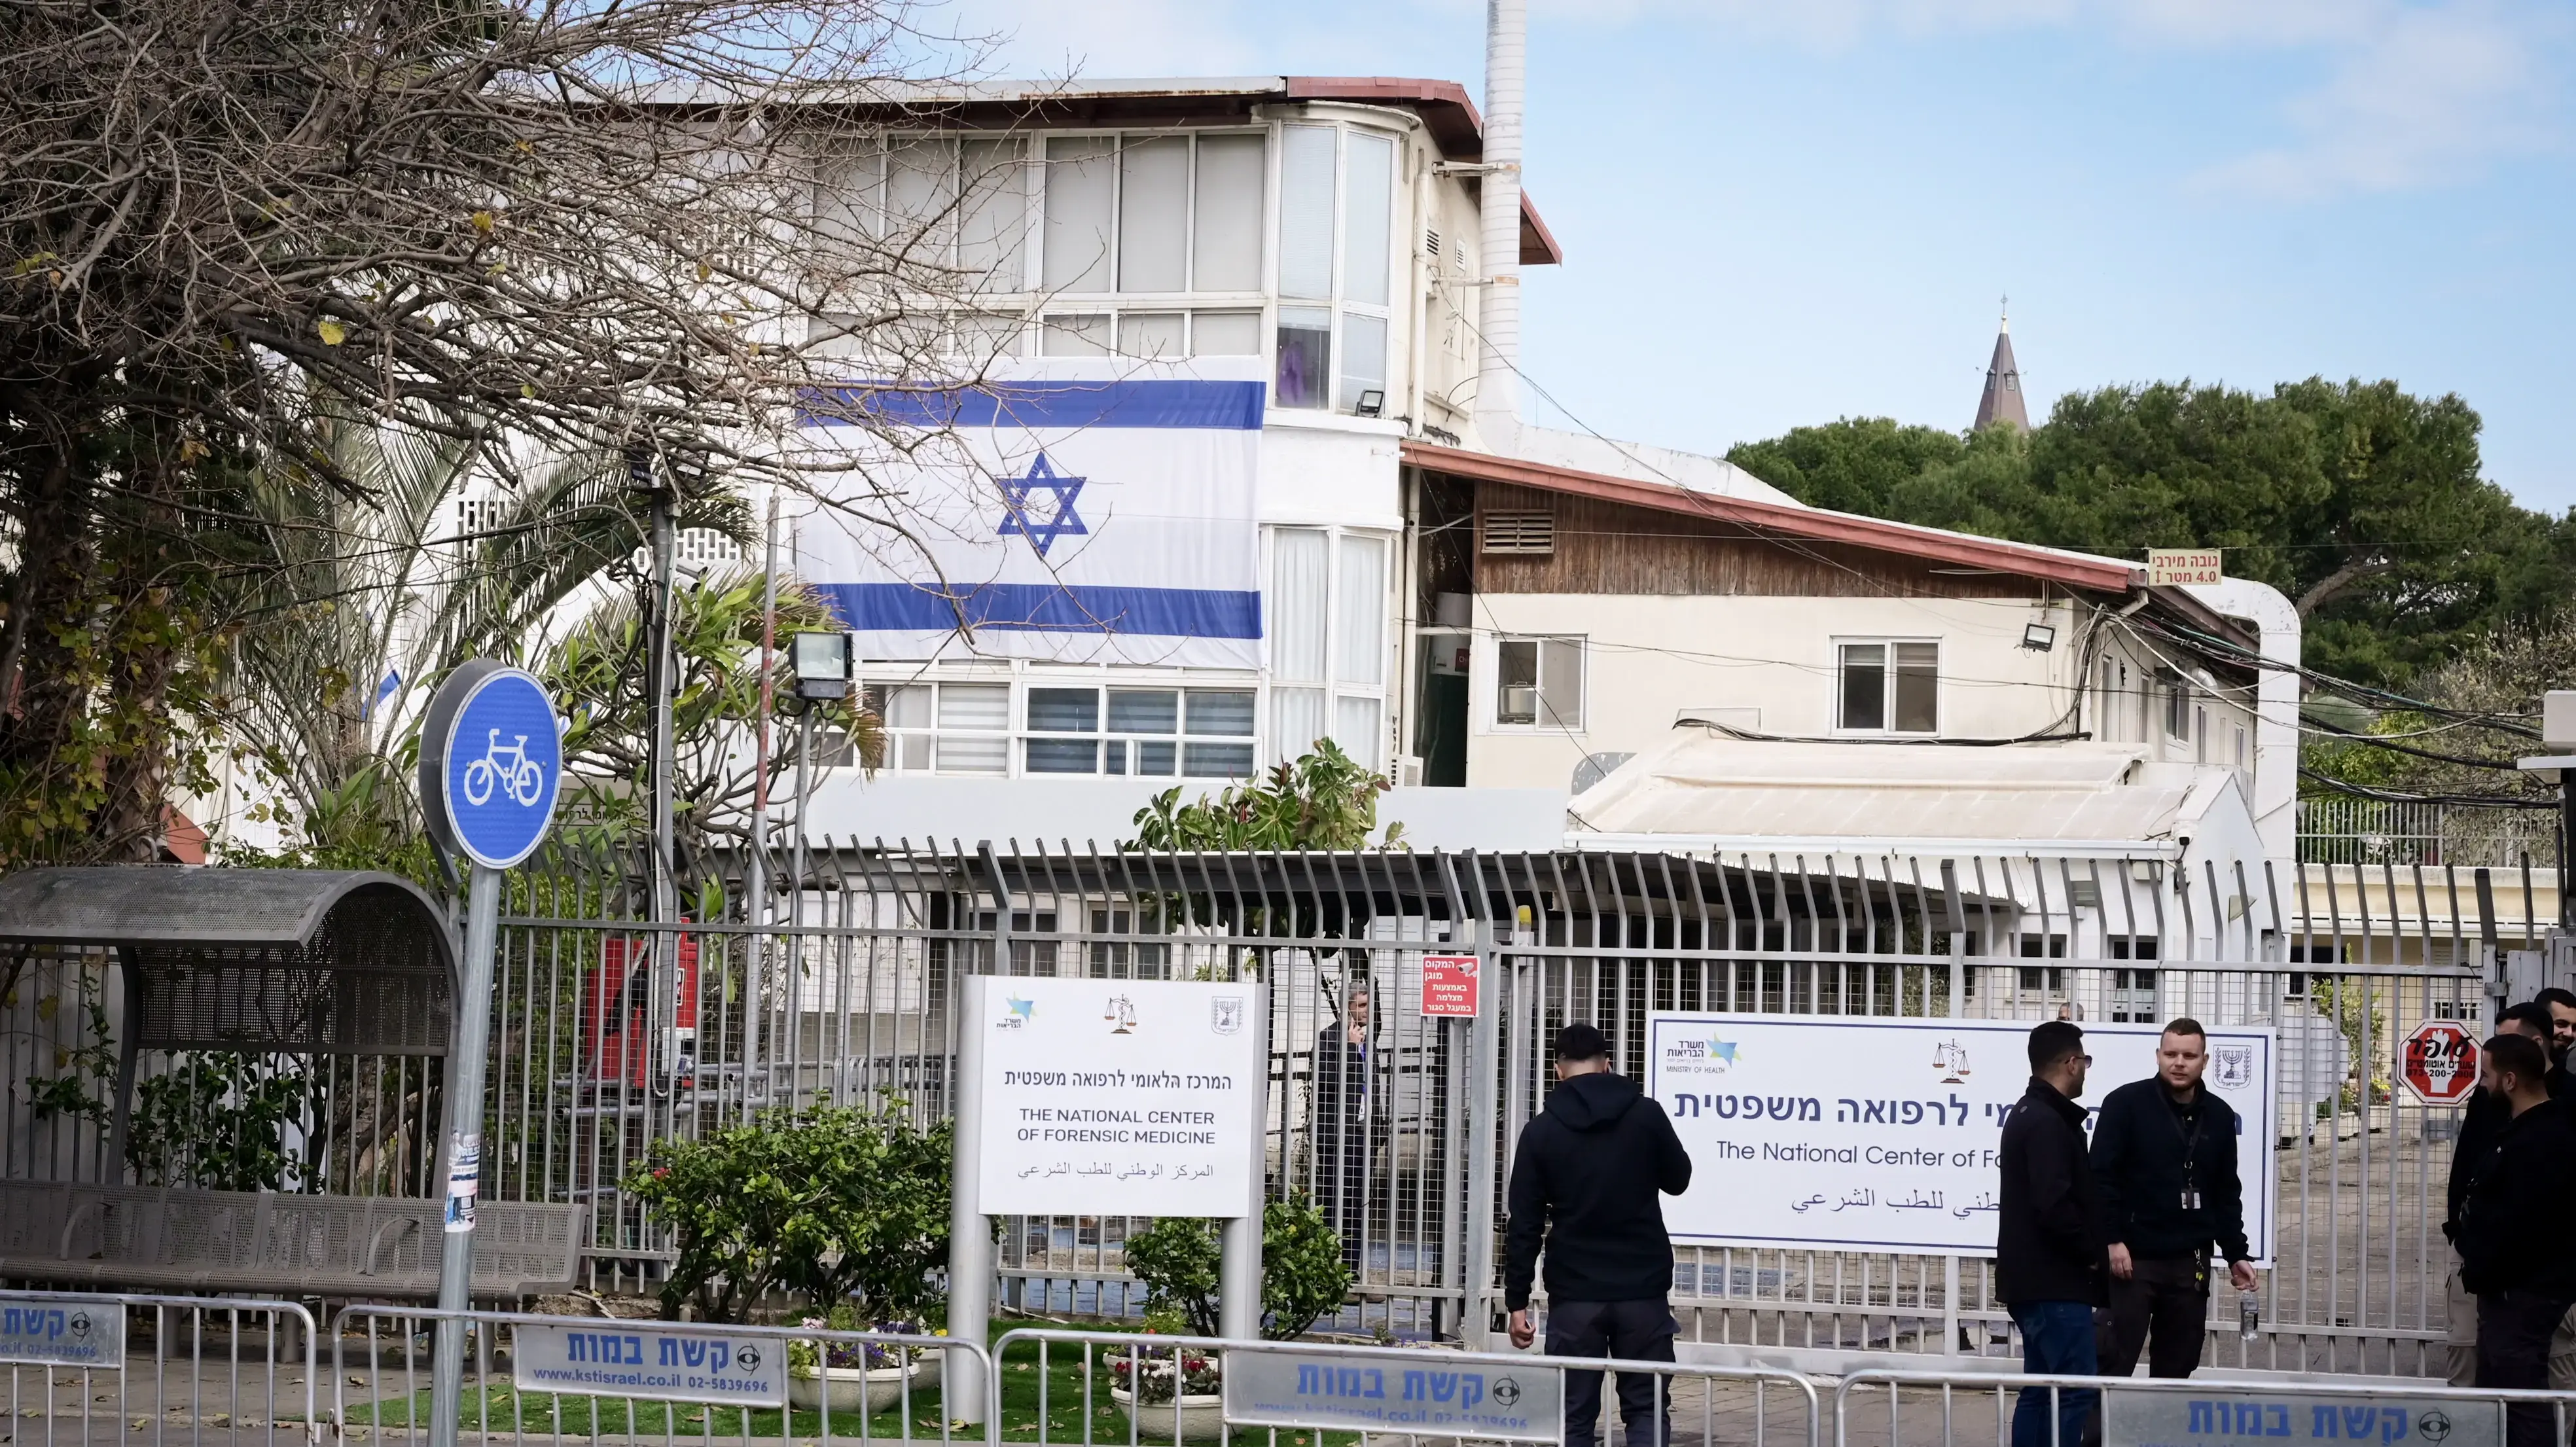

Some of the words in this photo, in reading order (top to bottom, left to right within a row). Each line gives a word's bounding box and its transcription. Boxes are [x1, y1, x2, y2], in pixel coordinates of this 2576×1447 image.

[2153, 556, 2186, 567] מירבי
[2191, 556, 2218, 567] גובה
[2166, 572, 2192, 582] מטר
[2196, 571, 2217, 582] 4.0
[1425, 960, 1455, 970] המקום
[1425, 972, 1443, 981] מוגן
[1437, 993, 1463, 1001] מצלמה
[1446, 1003, 1472, 1012] במעגל
[1667, 1049, 1704, 1058] הבריאות
[2408, 1035, 2473, 1058] סופר
[2448, 1060, 2475, 1069] שערים
[1005, 1070, 1066, 1086] משפטית
[1072, 1069, 1126, 1088] לרפואה
[1131, 1070, 1181, 1089] הלאומי
[1187, 1075, 1232, 1090] המרכז
[1019, 1108, 1052, 1122] THE
[1057, 1109, 1143, 1123] NATIONAL
[1148, 1111, 1215, 1124] CENTER
[1674, 1094, 1821, 1121] משפטית
[1838, 1094, 1968, 1126] לרפואה
[1017, 1128, 1039, 1141] OF
[1045, 1129, 1129, 1143] FORENSIC
[1134, 1131, 1216, 1145] MEDICINE
[1717, 1141, 1755, 1159] The
[1764, 1143, 1857, 1163] National
[1865, 1146, 1945, 1166] Center
[1952, 1150, 1976, 1167] of
[1018, 1162, 1070, 1179] الشرعي
[1077, 1162, 1112, 1179] للطب
[1116, 1164, 1163, 1181] الوطني
[1172, 1165, 1214, 1179] المركز
[1792, 1187, 1875, 1214] الشرعي
[1886, 1188, 1943, 1213] للطب
[4, 1308, 64, 1341] קשת
[567, 1332, 643, 1365] במות
[658, 1337, 729, 1374] קשת
[533, 1368, 681, 1388] www.kstisrael.co.il
[688, 1376, 768, 1393] 02-5839696
[1297, 1363, 1385, 1399] במות
[1403, 1369, 1484, 1410] קשת
[2188, 1401, 2291, 1437] במות
[2311, 1404, 2407, 1446] קשת
